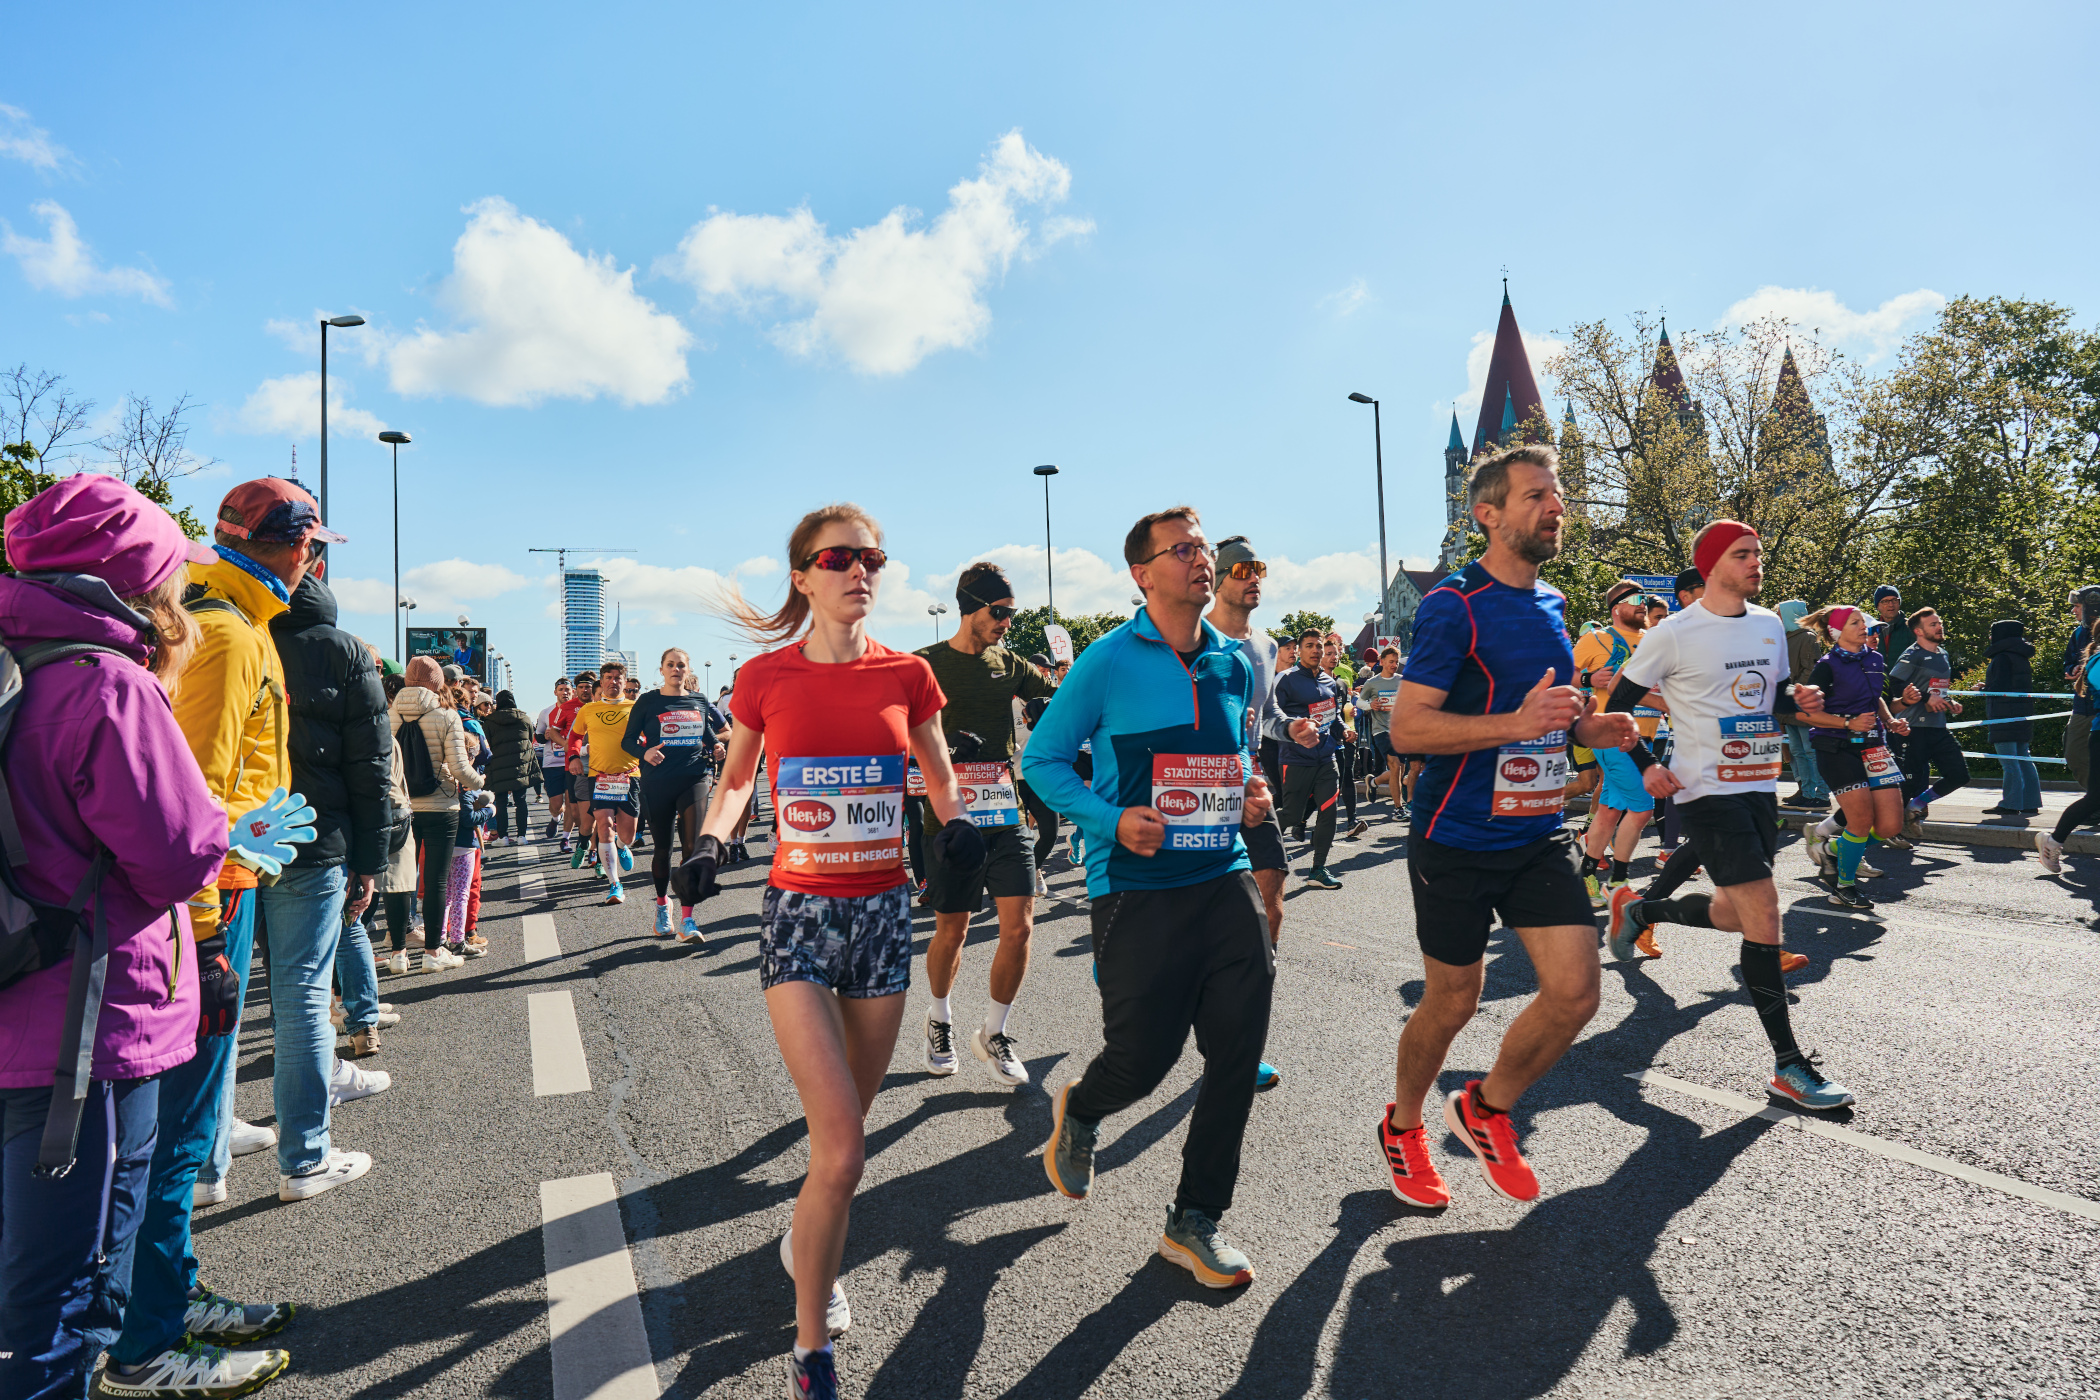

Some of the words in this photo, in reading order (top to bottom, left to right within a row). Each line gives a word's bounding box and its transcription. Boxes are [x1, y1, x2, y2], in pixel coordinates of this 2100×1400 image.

[1644, 579, 1665, 587] Budapest
[1725, 660, 1755, 670] BAVARIAN
[1735, 721, 1766, 732] ERSTE
[1753, 741, 1780, 755] Lukas
[1186, 757, 1227, 767] WIENER
[802, 766, 862, 785] ERSTE
[955, 772, 995, 780] TÄDTISCHE
[1164, 767, 1227, 778] STÄDTISCHE
[1504, 763, 1538, 777] Hervis
[982, 788, 1012, 800] Daniel
[1160, 795, 1196, 810] Hervis
[1202, 792, 1242, 812] Martin
[788, 806, 831, 825] Hervis
[847, 801, 896, 827] Molly
[1173, 833, 1218, 848] ERSTE
[813, 852, 850, 864] WIEN
[853, 848, 899, 862] ENERGIE
[1784, 1073, 1806, 1094] HOKA
[98, 1382, 152, 1398] SALOMON
